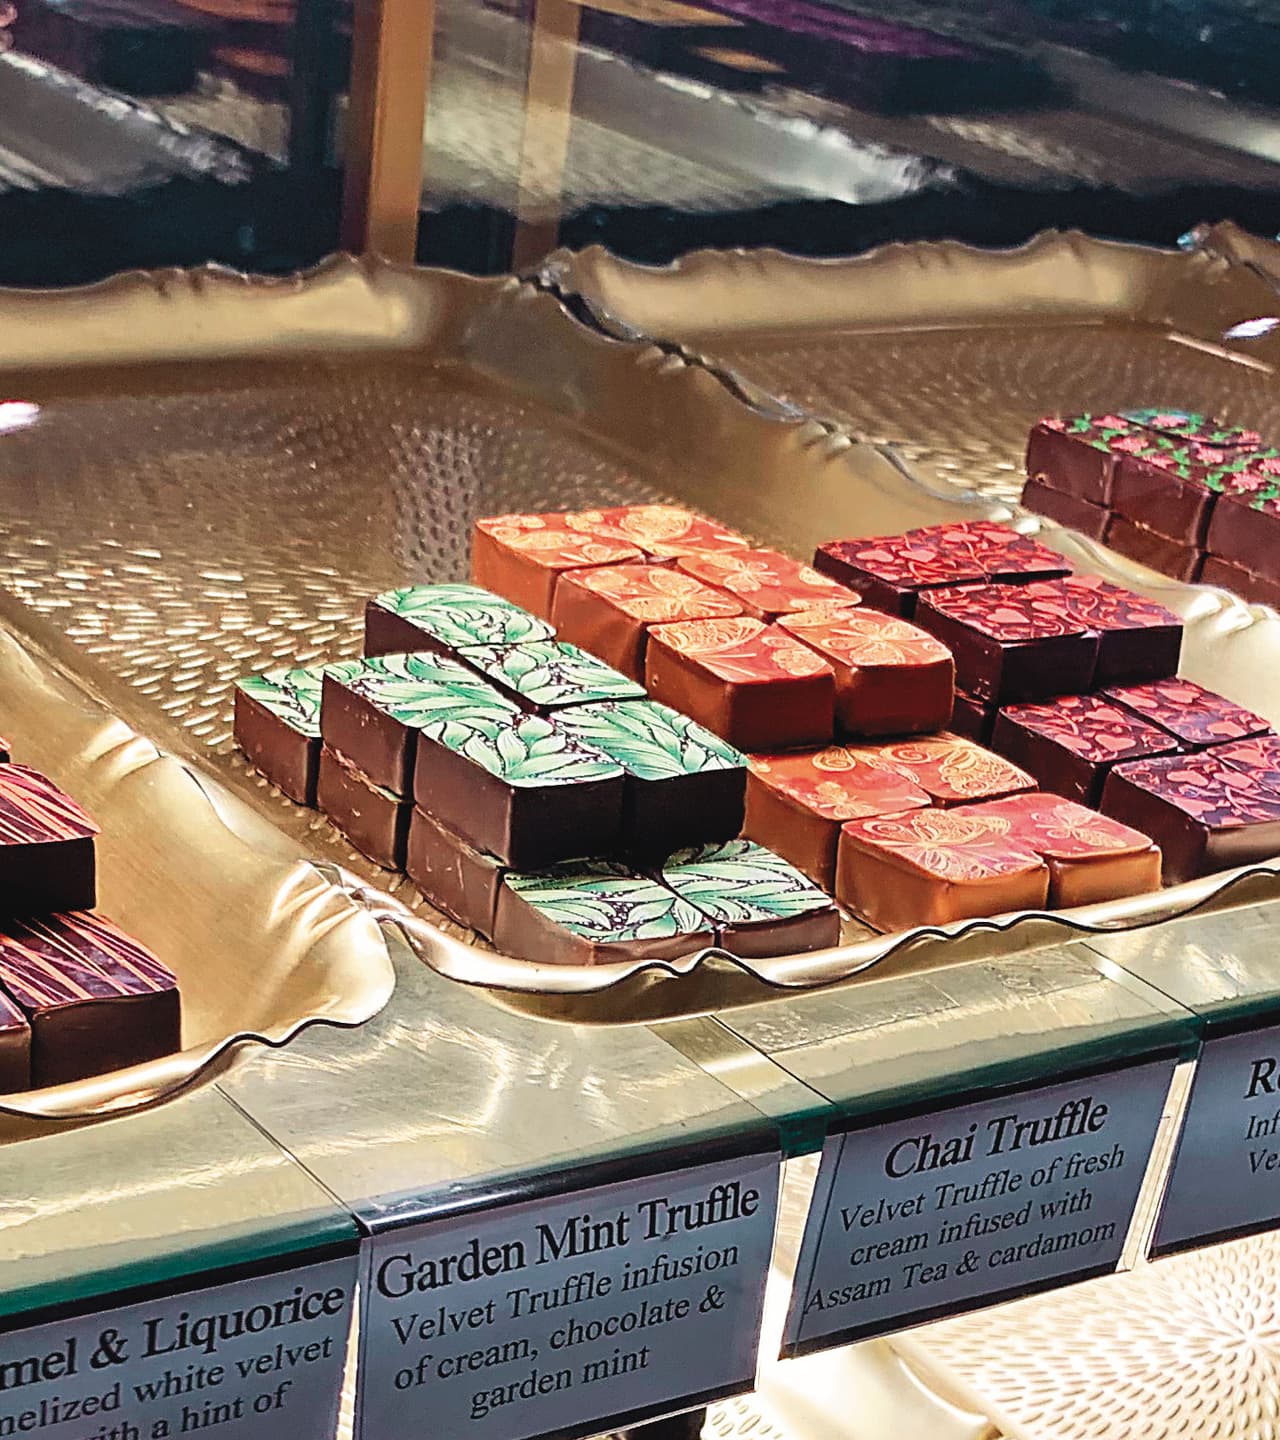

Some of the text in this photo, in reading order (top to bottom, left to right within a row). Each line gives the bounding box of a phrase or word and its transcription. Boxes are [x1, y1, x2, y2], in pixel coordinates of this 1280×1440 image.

[884, 1096, 1109, 1179] Chai Truffle
[840, 1143, 1126, 1233] Velvet Truffle of fresh
[850, 1188, 1092, 1266] cream infused with
[376, 1180, 760, 1298] Garden Mint Truffle
[803, 1220, 1117, 1315] Assam Tea & cardamom
[89, 1327, 129, 1370] &
[140, 1285, 346, 1360] Liquorice
[390, 1246, 740, 1345] Velvet Truffle infusion
[394, 1285, 726, 1390] of cream, chocolate &
[133, 1361, 225, 1402] white
[235, 1335, 334, 1378] velvet
[151, 1414, 170, 1438] a
[181, 1397, 245, 1433] hint
[253, 1380, 294, 1414] of
[470, 1344, 651, 1420] garden mint
